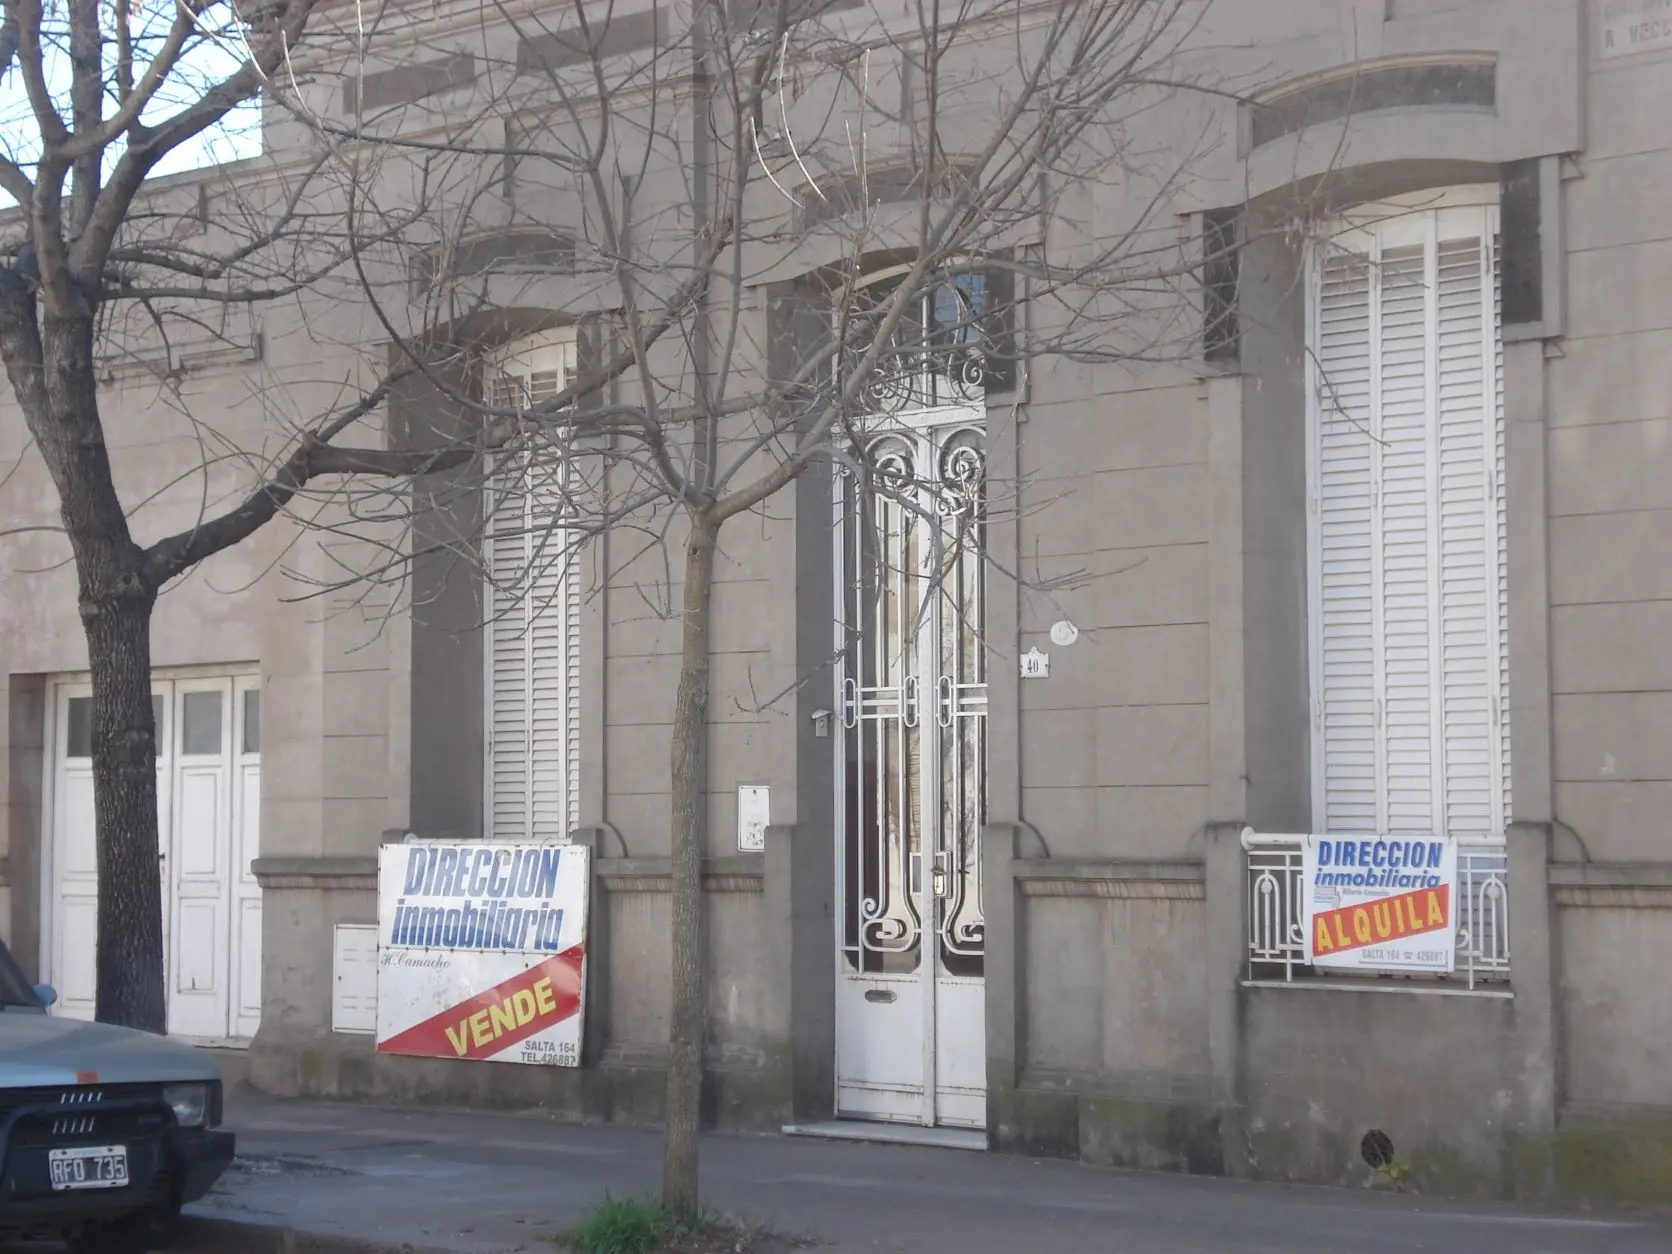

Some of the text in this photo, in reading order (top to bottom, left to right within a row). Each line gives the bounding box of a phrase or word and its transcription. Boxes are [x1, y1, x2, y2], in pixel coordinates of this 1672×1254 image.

[1027, 658, 1039, 673] 40
[1318, 841, 1443, 868] DIRECCION
[403, 847, 561, 898] DIRECCION
[1314, 868, 1441, 888] inmobiliaria
[391, 899, 564, 950] inmobiliaria
[1316, 891, 1444, 953] ALQUILA
[1362, 949, 1384, 959] SALTA
[445, 976, 557, 1057] VENDE
[524, 1040, 575, 1053] SALTA 164
[94, 1156, 126, 1180] 735
